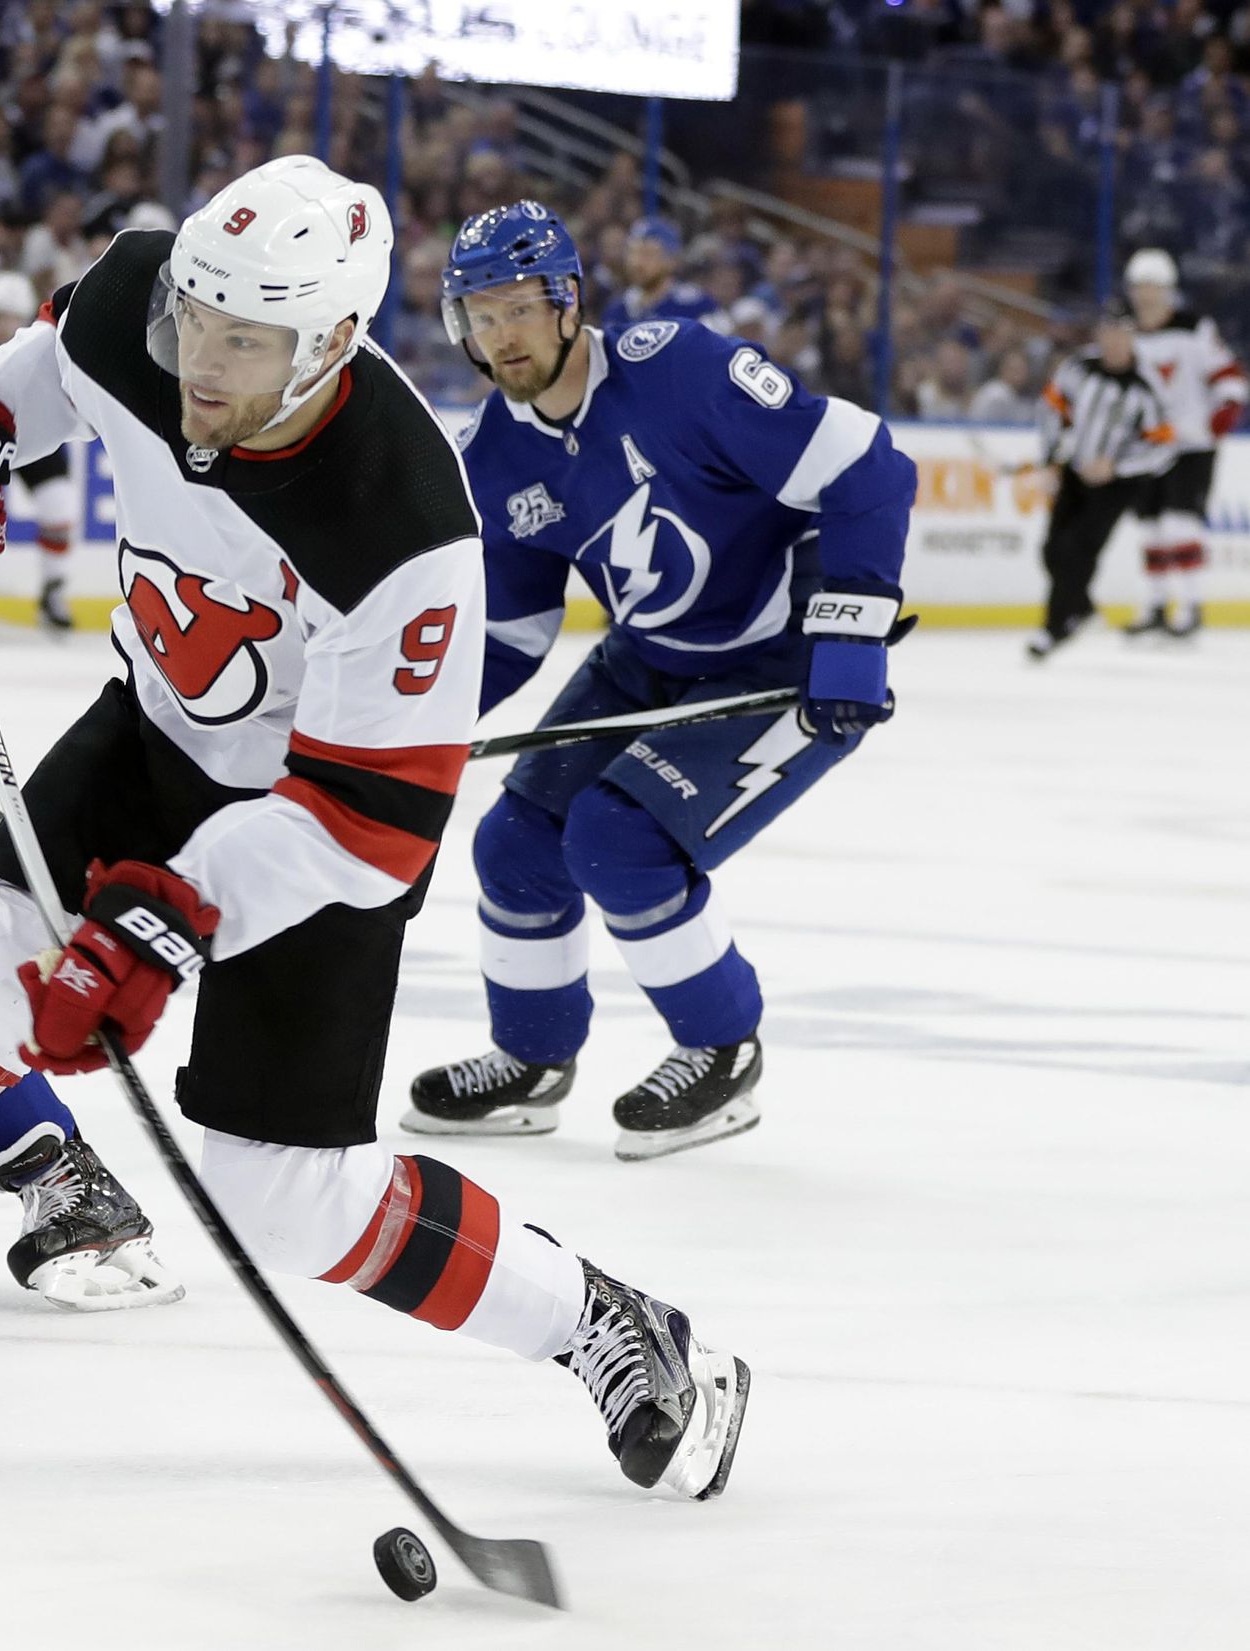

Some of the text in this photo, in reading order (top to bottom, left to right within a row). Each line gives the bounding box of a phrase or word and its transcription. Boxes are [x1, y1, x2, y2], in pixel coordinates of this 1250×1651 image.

[222, 206, 257, 236] 9
[727, 346, 794, 410] 6
[620, 433, 657, 486] A
[392, 603, 458, 696] 9
